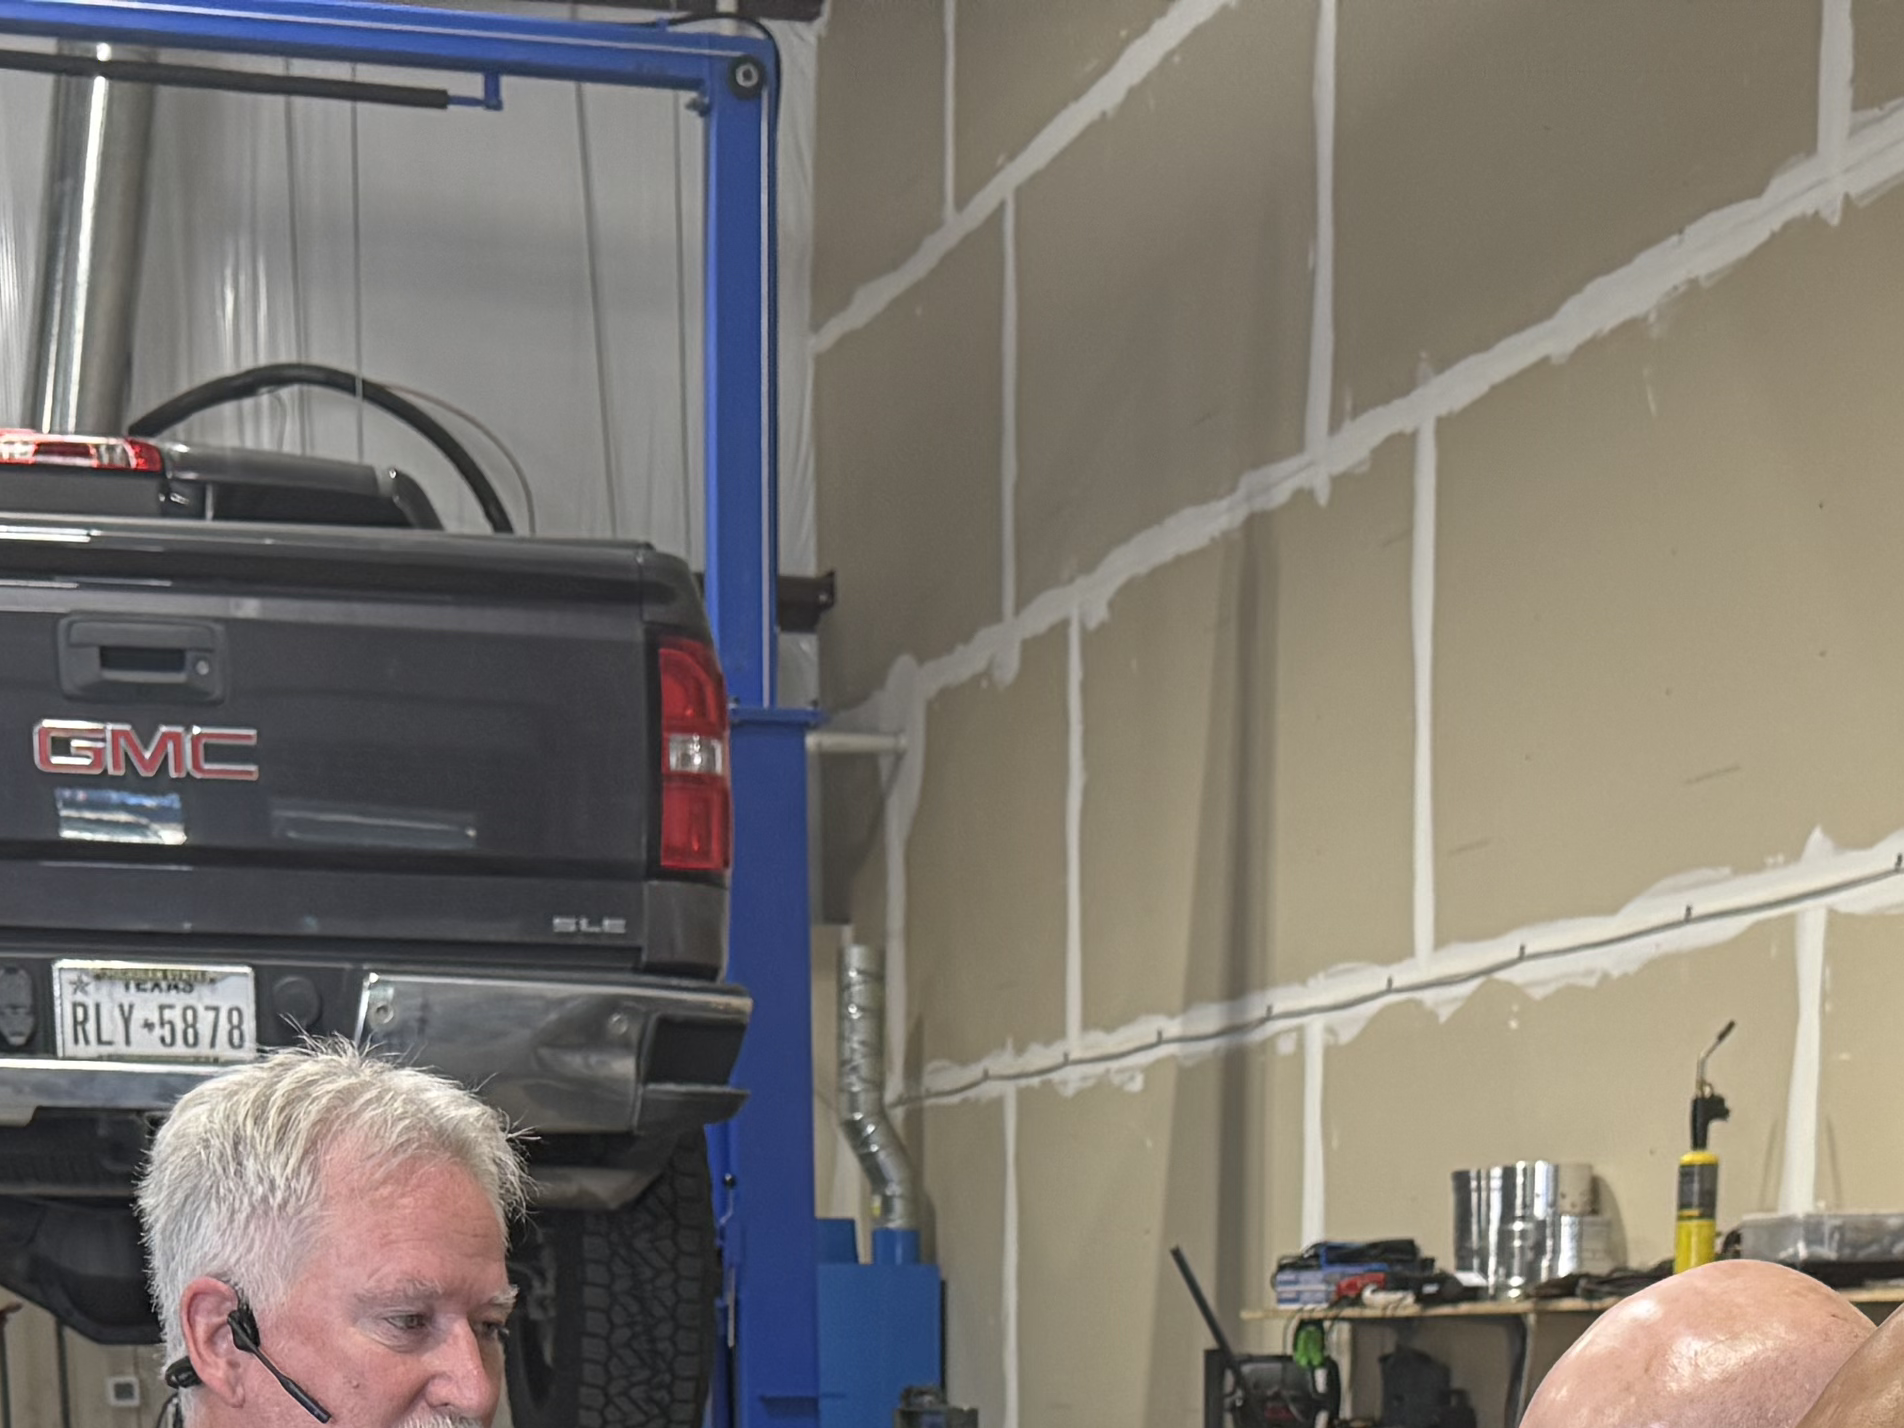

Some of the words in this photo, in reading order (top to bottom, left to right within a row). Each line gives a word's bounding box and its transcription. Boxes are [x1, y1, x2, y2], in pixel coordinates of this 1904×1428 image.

[33, 718, 259, 781] GMC
[552, 915, 626, 934] SLE
[71, 1002, 134, 1047] RLY
[159, 1004, 245, 1050] 5878
